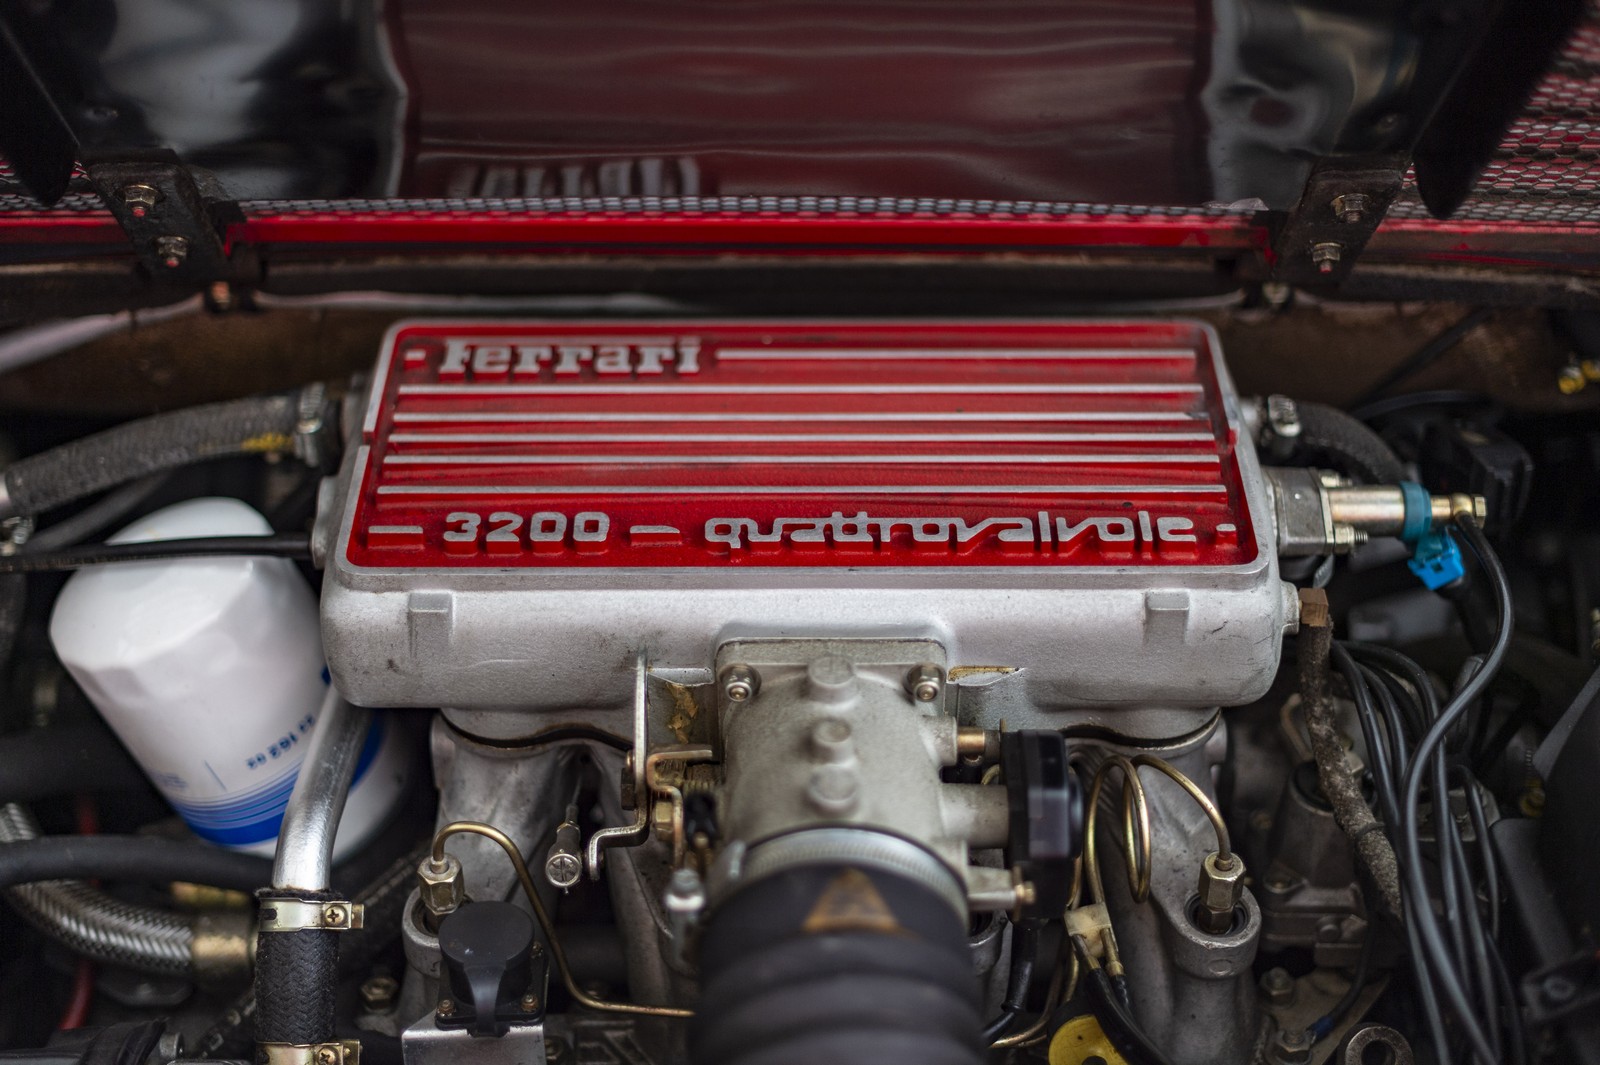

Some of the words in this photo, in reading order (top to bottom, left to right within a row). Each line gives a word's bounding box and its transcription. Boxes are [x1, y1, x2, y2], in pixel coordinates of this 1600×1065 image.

[438, 335, 700, 374] Ferrari
[443, 511, 611, 544] 3200
[704, 510, 1198, 550] quattrovalvole
